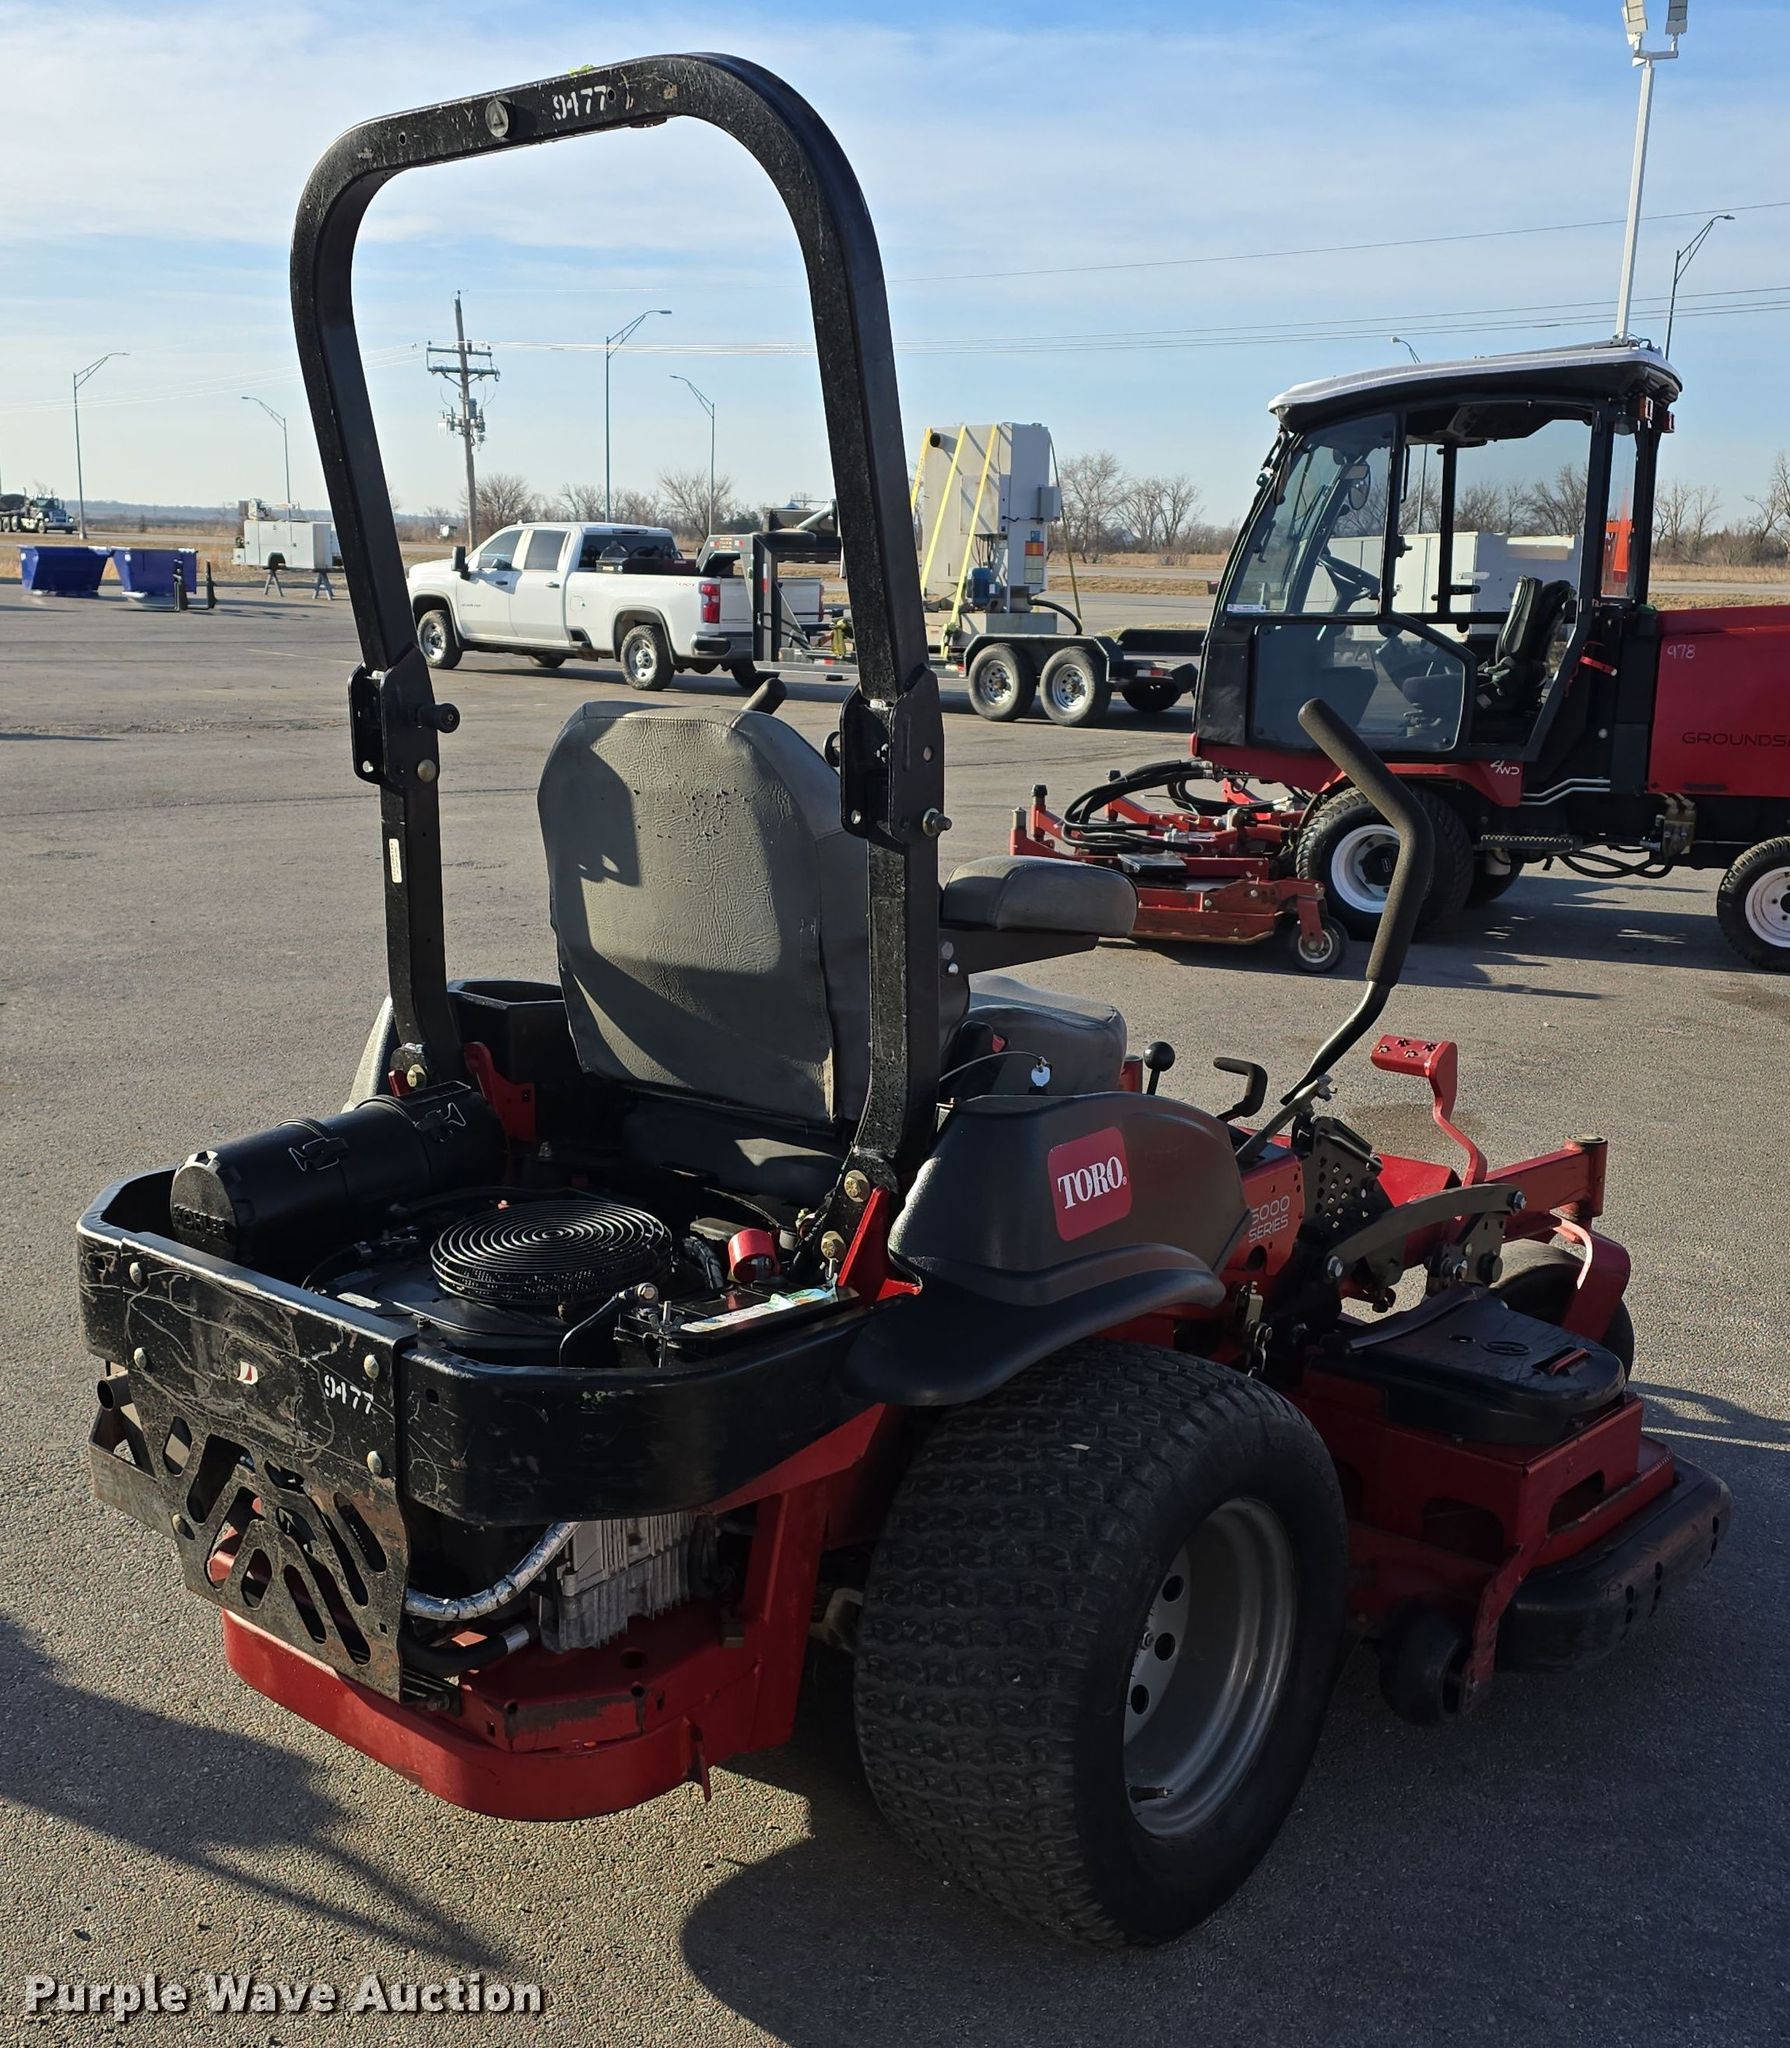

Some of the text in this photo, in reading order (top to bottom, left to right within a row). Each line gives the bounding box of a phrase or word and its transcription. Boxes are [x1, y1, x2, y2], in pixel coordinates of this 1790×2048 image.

[552, 85, 607, 121] 9477
[1667, 644, 1696, 660] 978
[1682, 731, 1790, 748] GROUNDS
[1490, 759, 1520, 775] 4WD
[1057, 1155, 1125, 1210] TORO
[1248, 1214, 1289, 1243] SERIES
[324, 1374, 374, 1414] 9477
